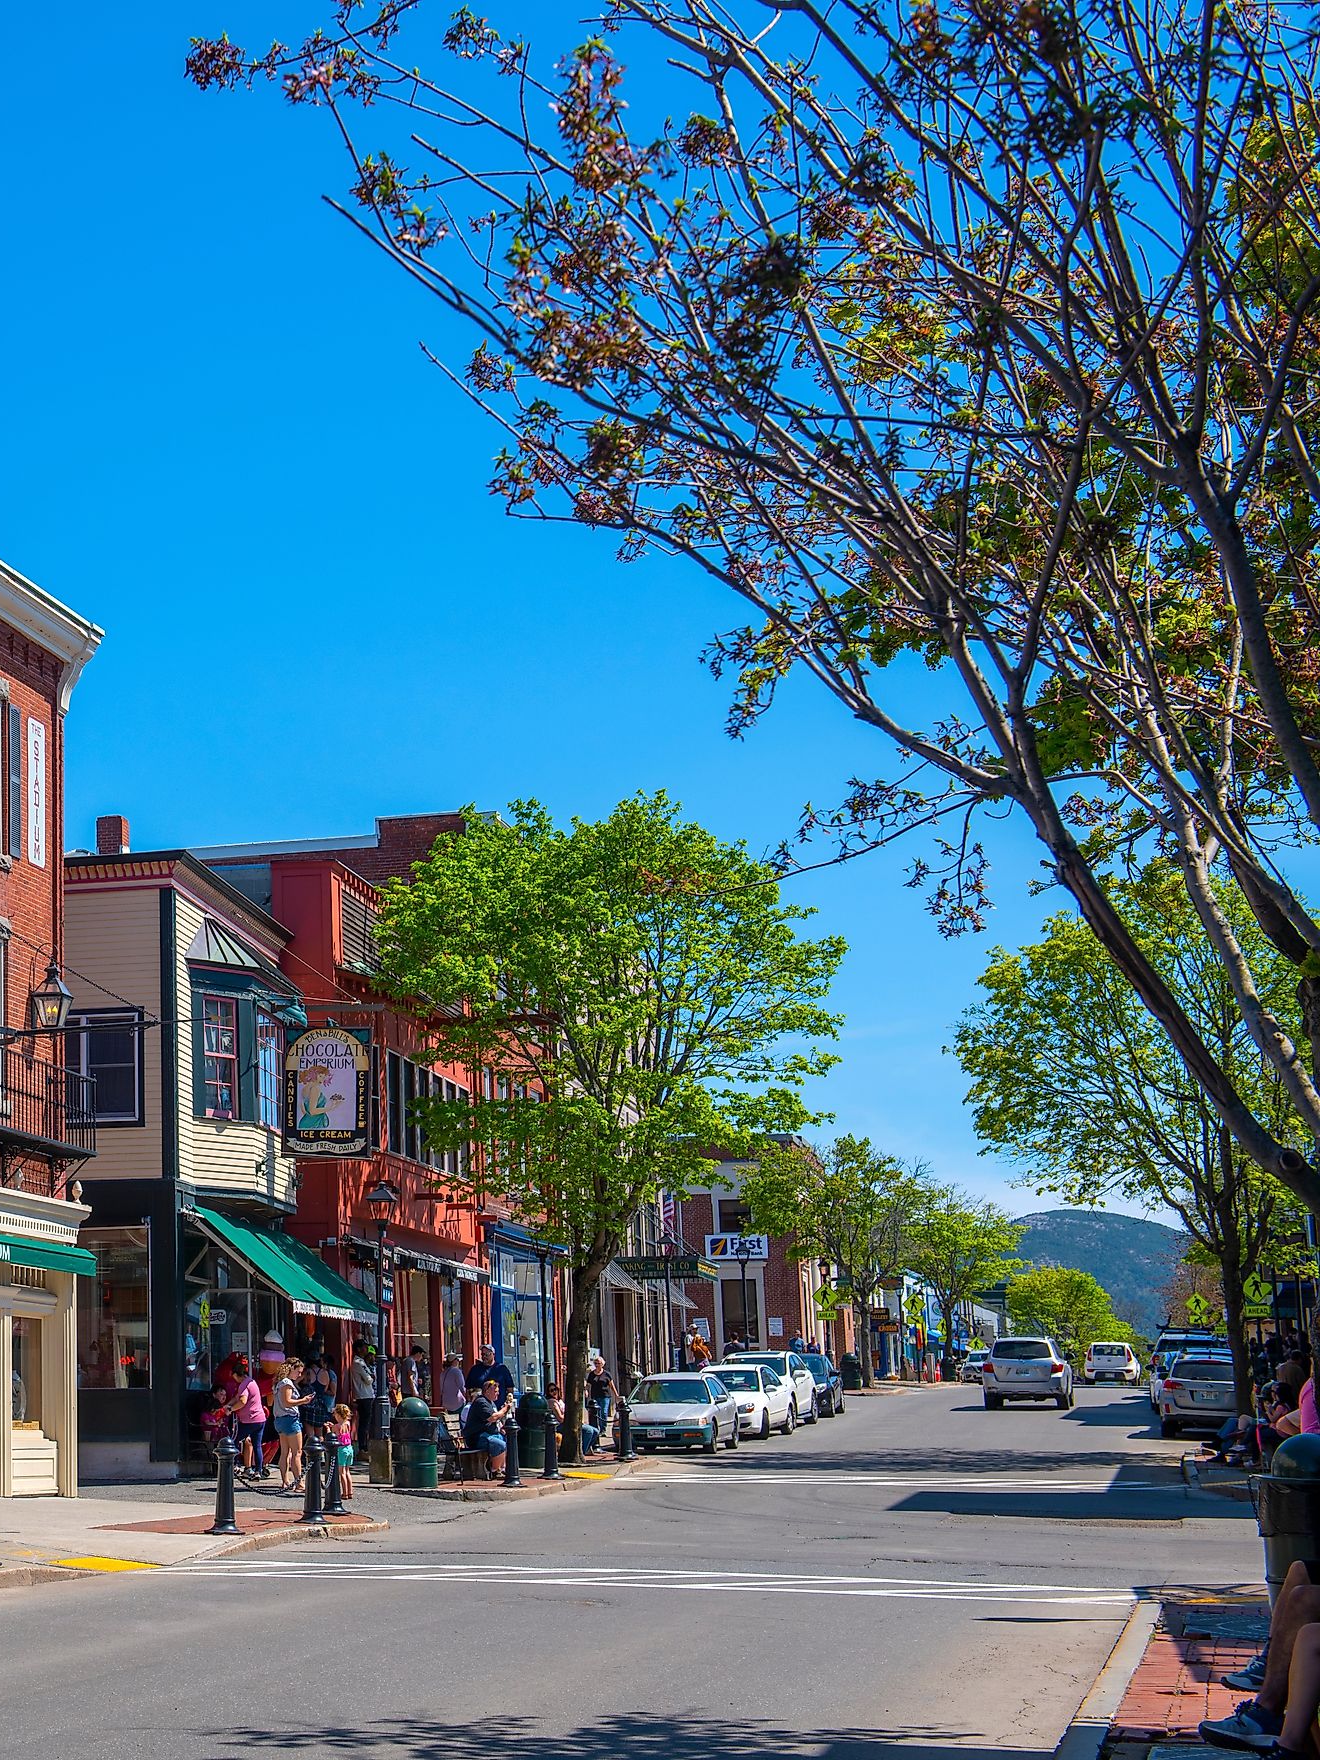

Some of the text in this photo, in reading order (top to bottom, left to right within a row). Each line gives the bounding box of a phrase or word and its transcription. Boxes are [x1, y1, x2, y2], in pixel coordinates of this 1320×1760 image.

[31, 722, 42, 738] THE
[33, 740, 41, 861] STADIUM
[328, 1029, 350, 1044] BILL'S
[287, 1043, 369, 1057] CHOCOLATE
[299, 1058, 356, 1070] EMPORIUM
[287, 1071, 295, 1127] CANDIES
[358, 1071, 366, 1121] COFFEE
[319, 1131, 352, 1139] CREAM
[294, 1141, 314, 1150] MADE
[338, 1144, 358, 1152] DAILY
[656, 1262, 677, 1271] TRST
[680, 1262, 690, 1270] CO
[1248, 1307, 1268, 1315] AHEAD
